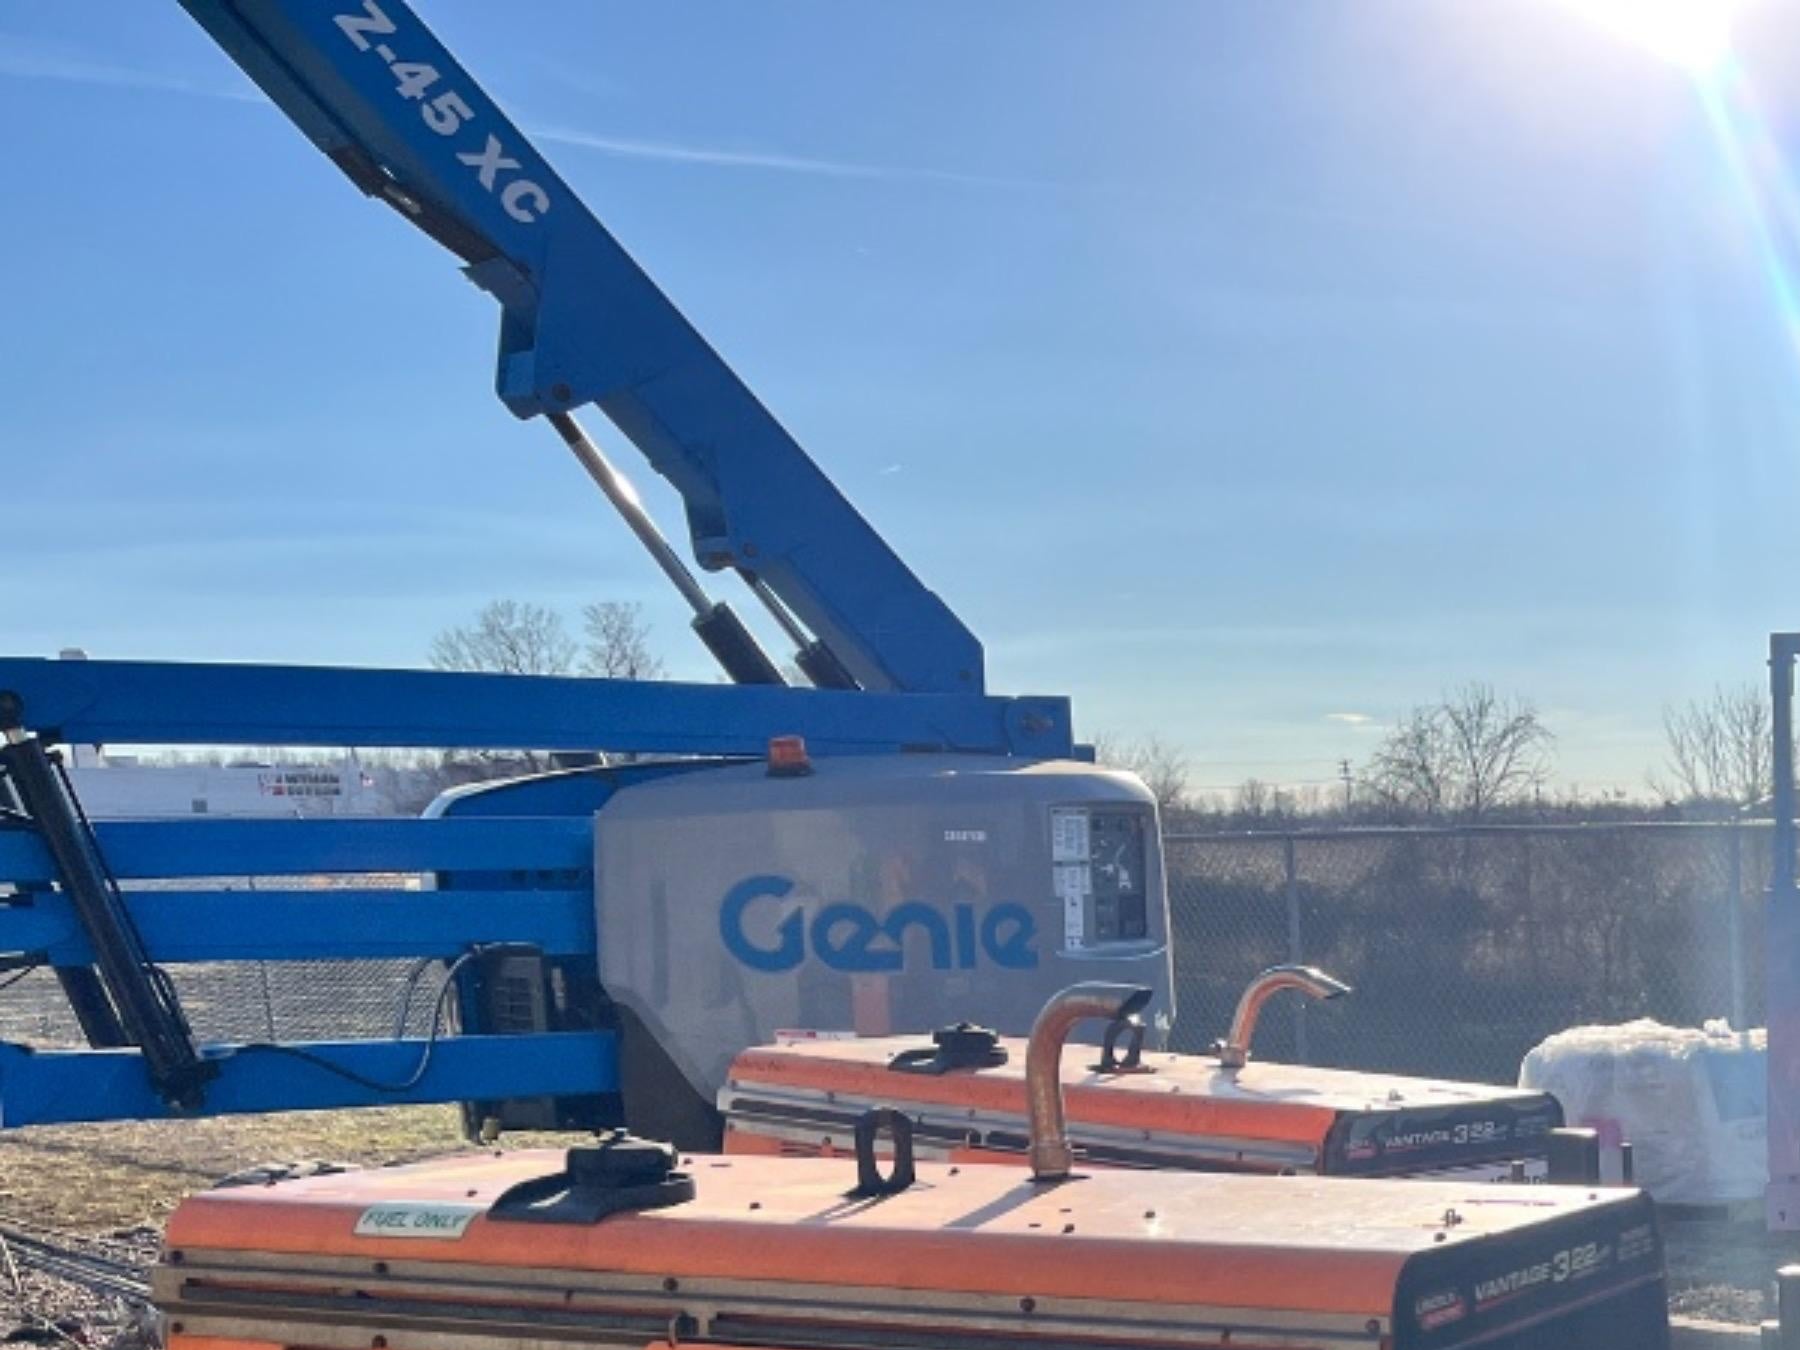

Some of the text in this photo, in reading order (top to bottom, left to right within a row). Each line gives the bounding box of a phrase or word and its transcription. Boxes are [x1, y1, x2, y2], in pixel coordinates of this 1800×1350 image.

[333, 0, 550, 223] Z-45 XC
[720, 874, 1038, 972] Genie
[1475, 1262, 1554, 1301] VANTAGE
